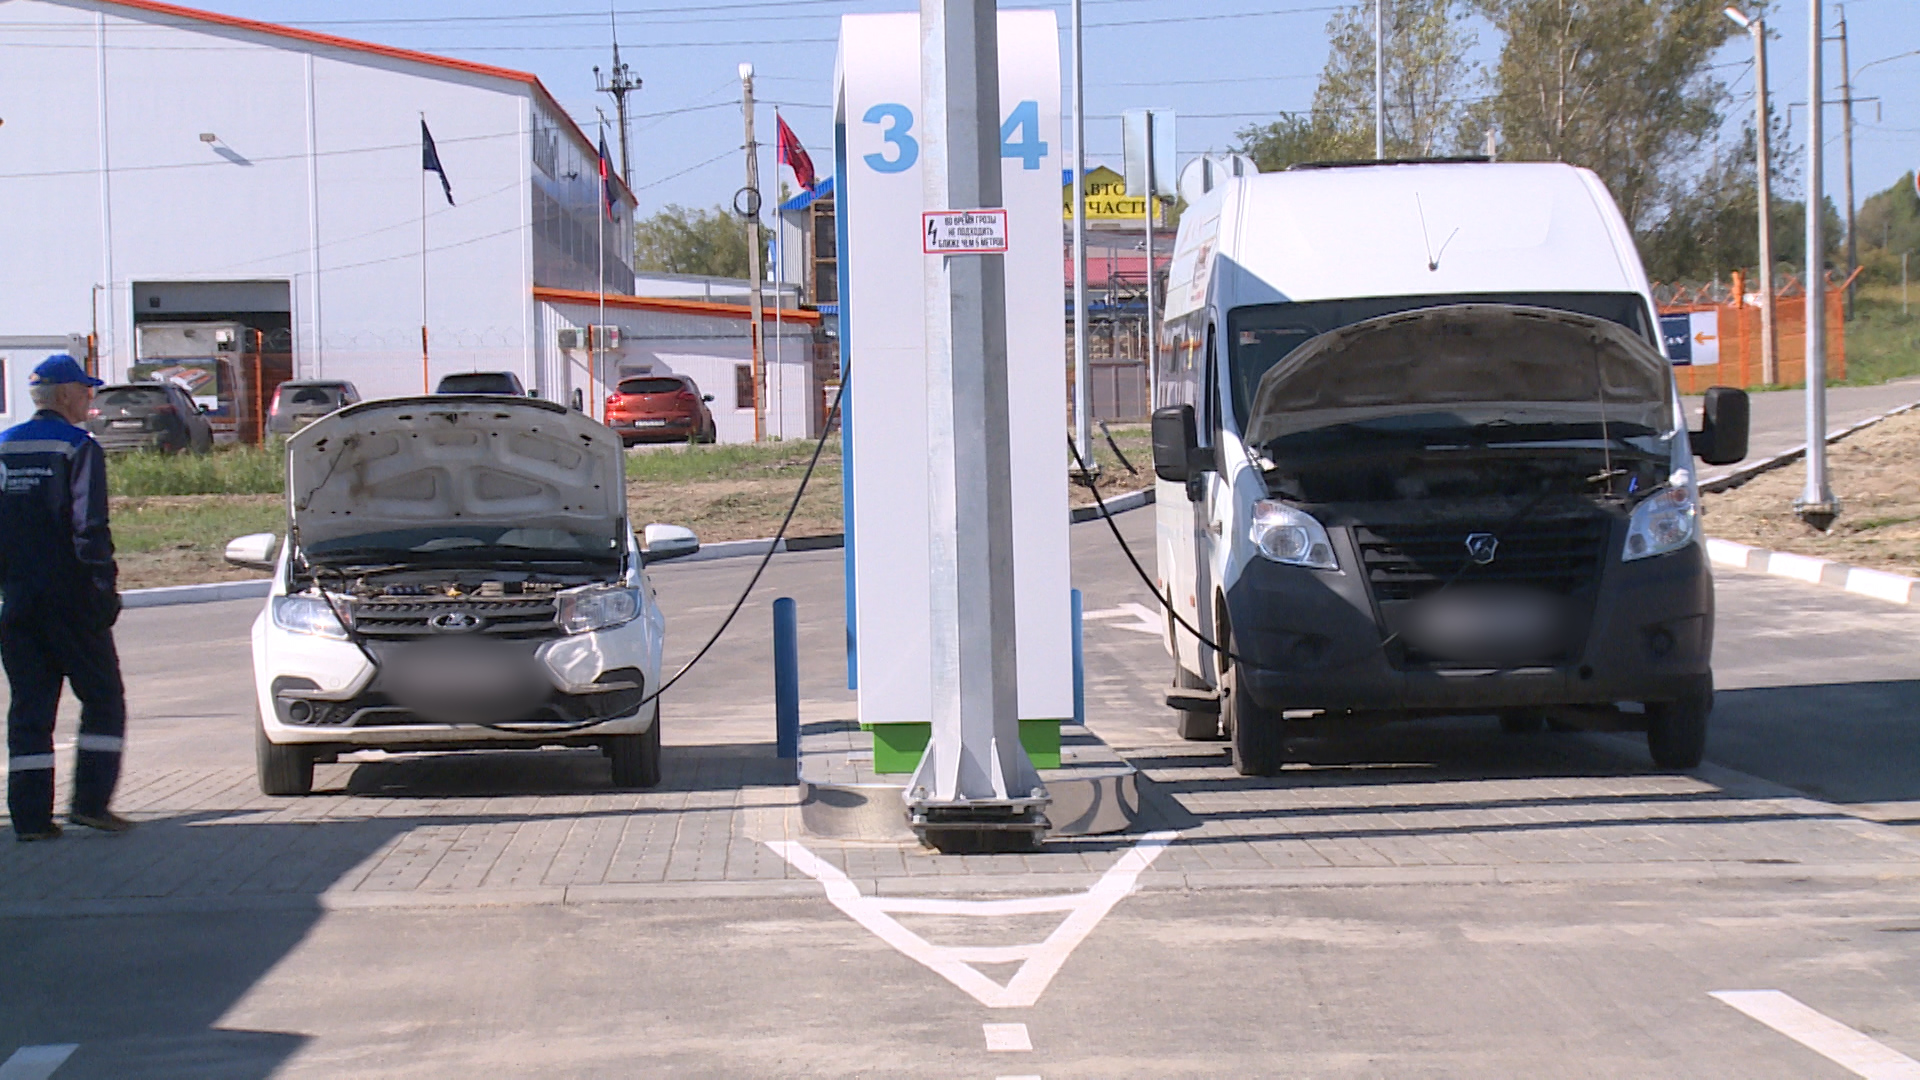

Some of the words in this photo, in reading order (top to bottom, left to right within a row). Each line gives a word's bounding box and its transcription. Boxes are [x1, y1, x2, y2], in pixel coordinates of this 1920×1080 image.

[862, 102, 919, 174] 3
[1000, 100, 1048, 170] 4
[1084, 183, 1126, 196] ВТО
[945, 217, 953, 226] ВО
[976, 215, 997, 224] ГРОЗЫ
[948, 228, 956, 237] НЕ
[957, 227, 994, 236] ПОДХОДИТЬ
[938, 239, 960, 248] БЛИЖЕ
[961, 238, 974, 248] ЧЕМ
[981, 237, 1004, 246] МЕТРОВ
